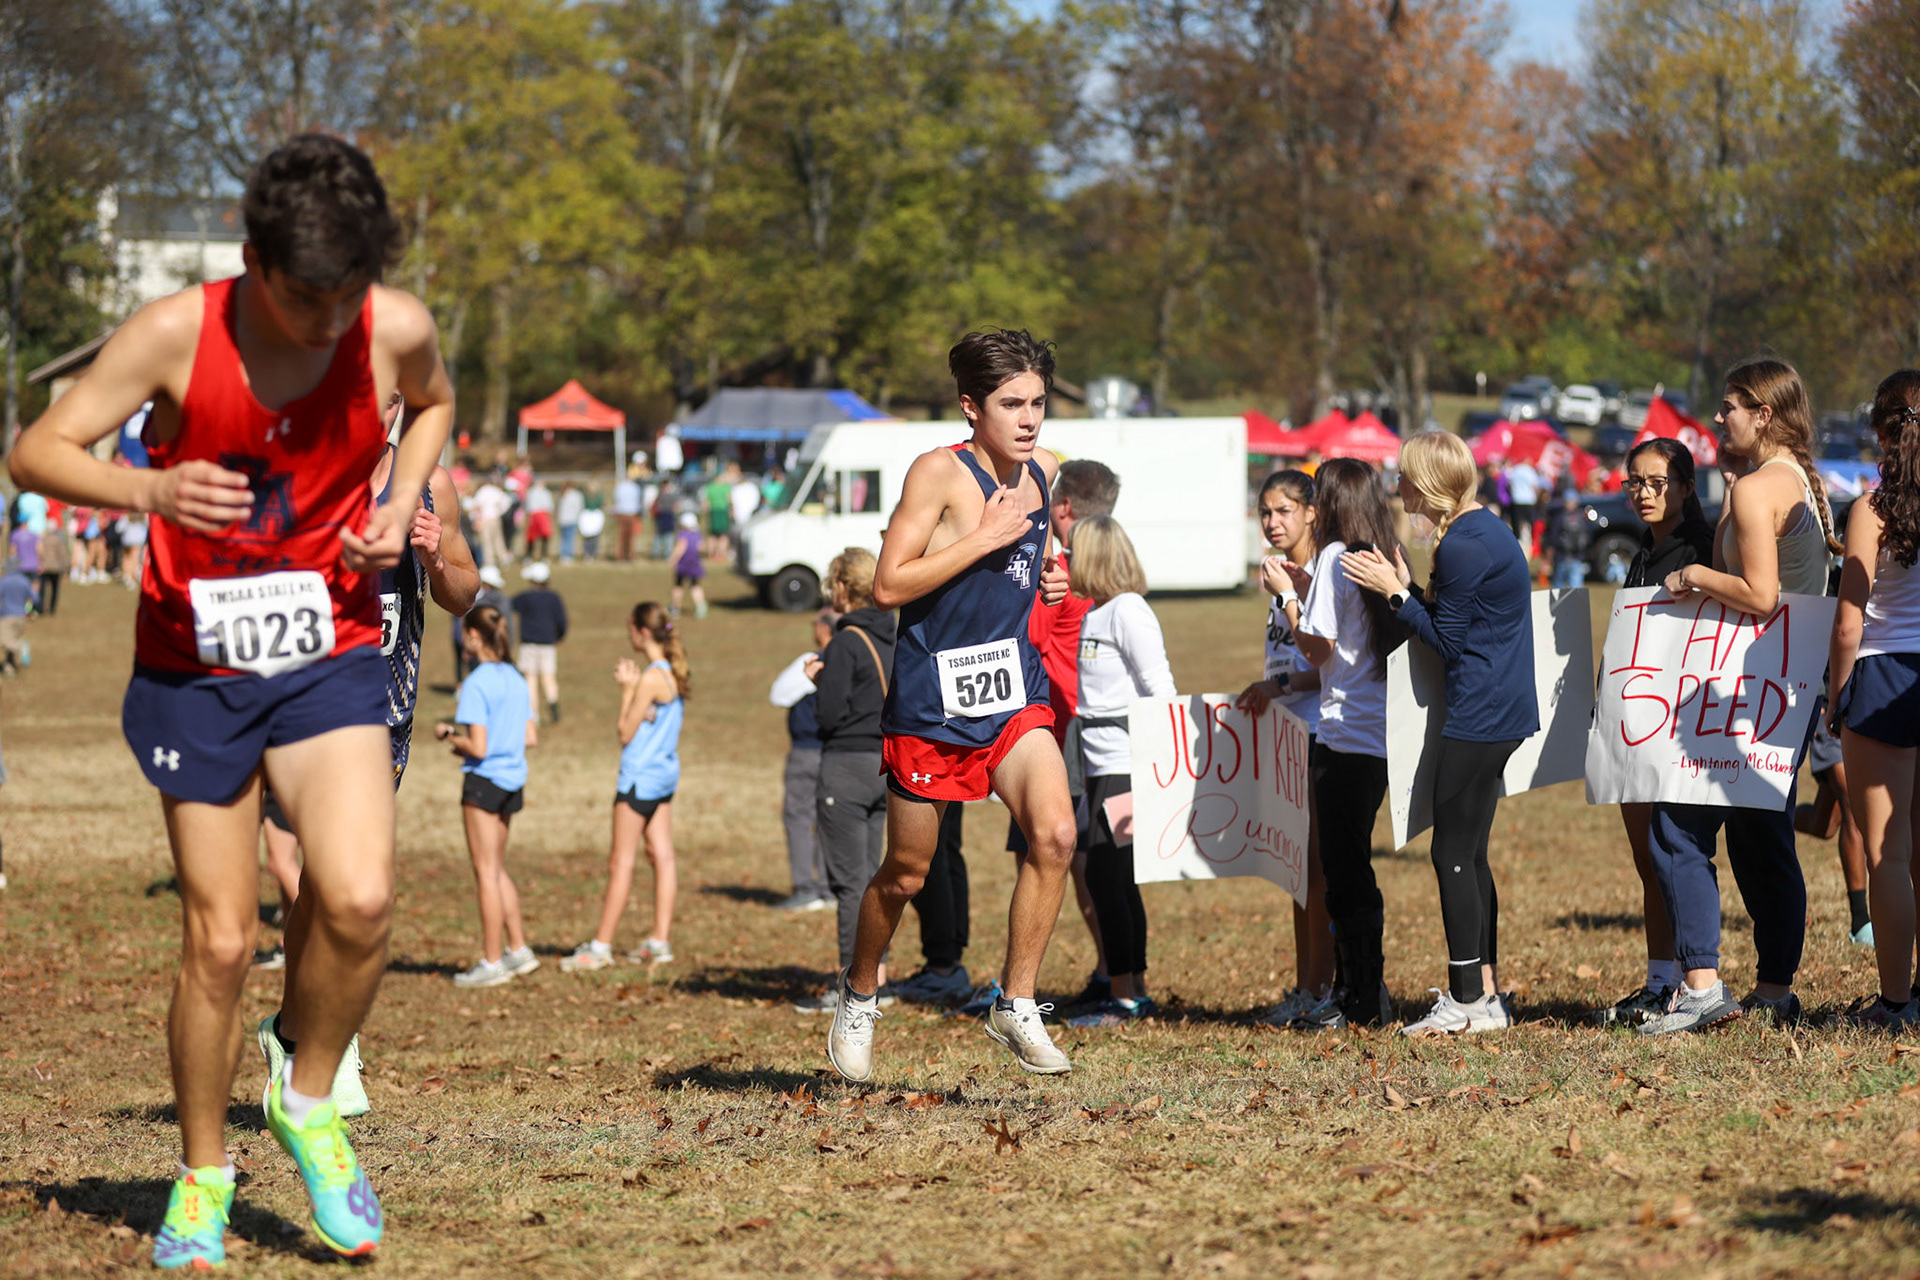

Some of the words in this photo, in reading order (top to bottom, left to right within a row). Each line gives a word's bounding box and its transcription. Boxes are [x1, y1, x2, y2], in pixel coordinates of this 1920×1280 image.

[382, 602, 394, 612] XC
[1680, 596, 1790, 678] AM
[207, 608, 322, 668] 1023
[948, 655, 977, 669] TSSAA
[977, 650, 1000, 664] STATE
[1000, 647, 1011, 659] XC
[955, 667, 1012, 708] 520
[1152, 702, 1261, 789] JUST
[1272, 707, 1307, 811] KEEP
[1157, 792, 1304, 894] Running
